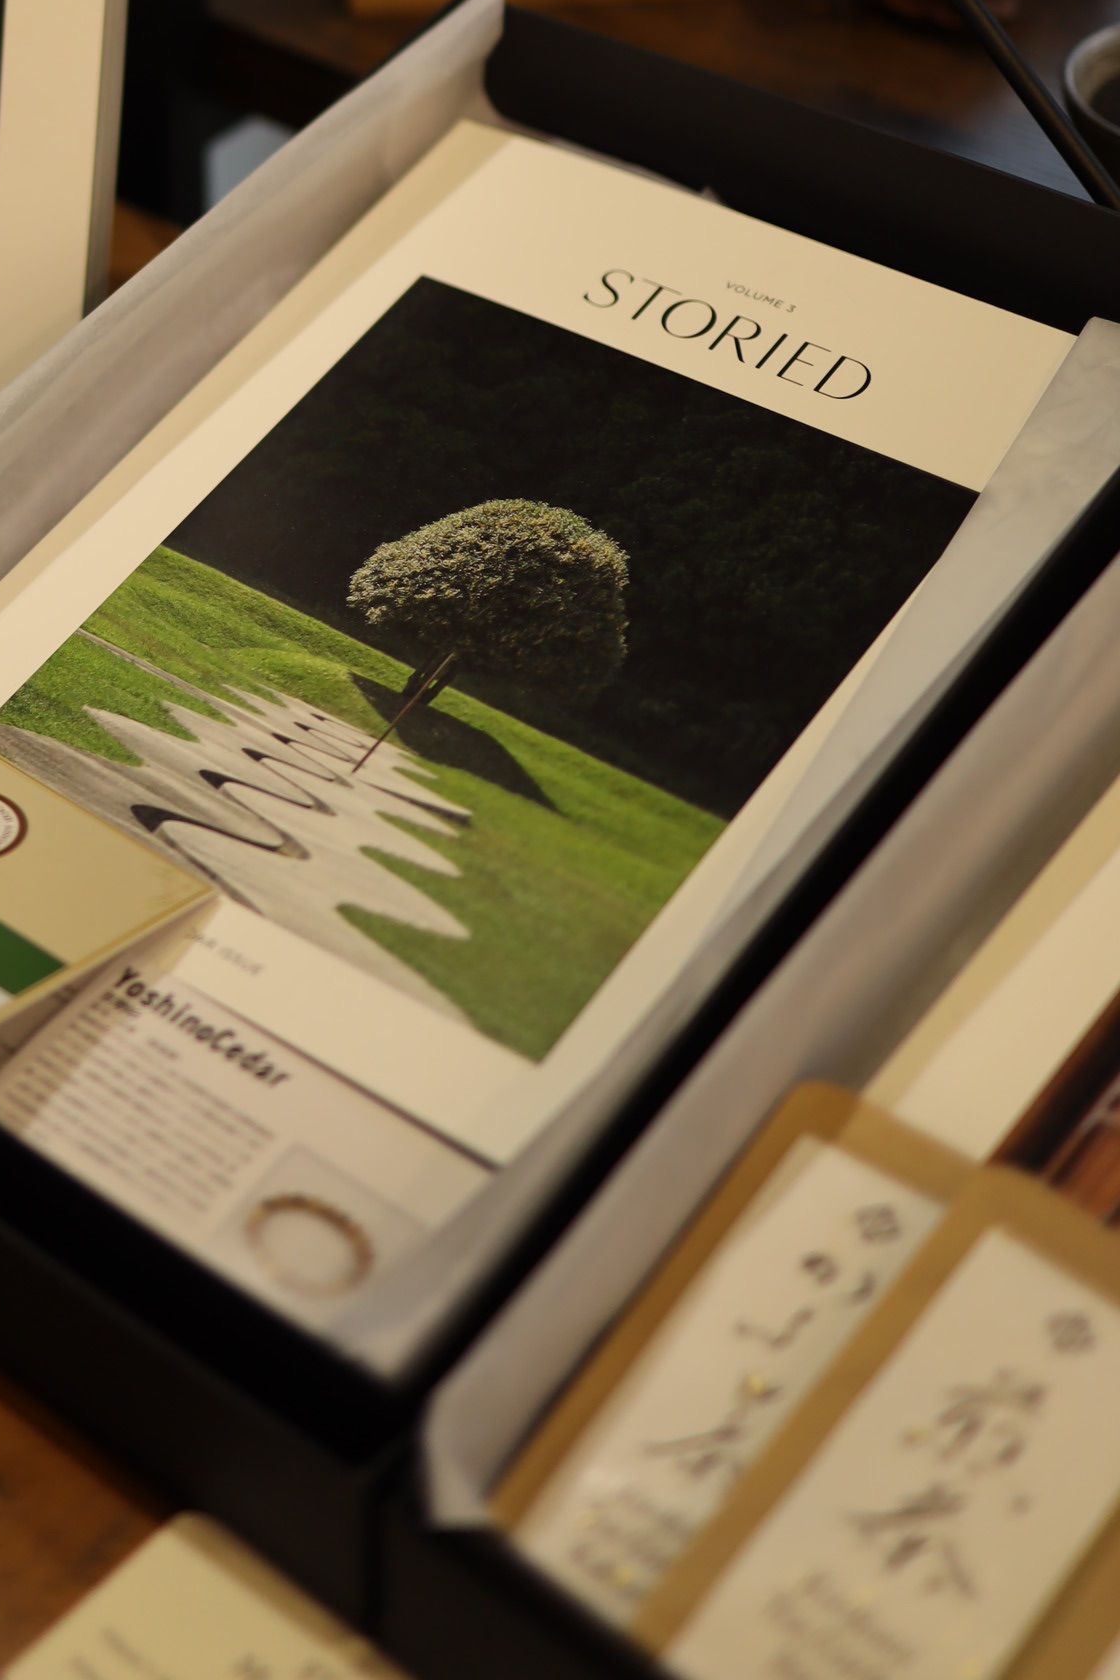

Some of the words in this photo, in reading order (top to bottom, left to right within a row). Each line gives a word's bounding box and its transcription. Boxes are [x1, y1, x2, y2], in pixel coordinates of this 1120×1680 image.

[583, 269, 873, 400] STORIED
[726, 281, 784, 309] VOLUME
[786, 304, 797, 314] 3
[115, 968, 291, 1088] YoshinoCedar
